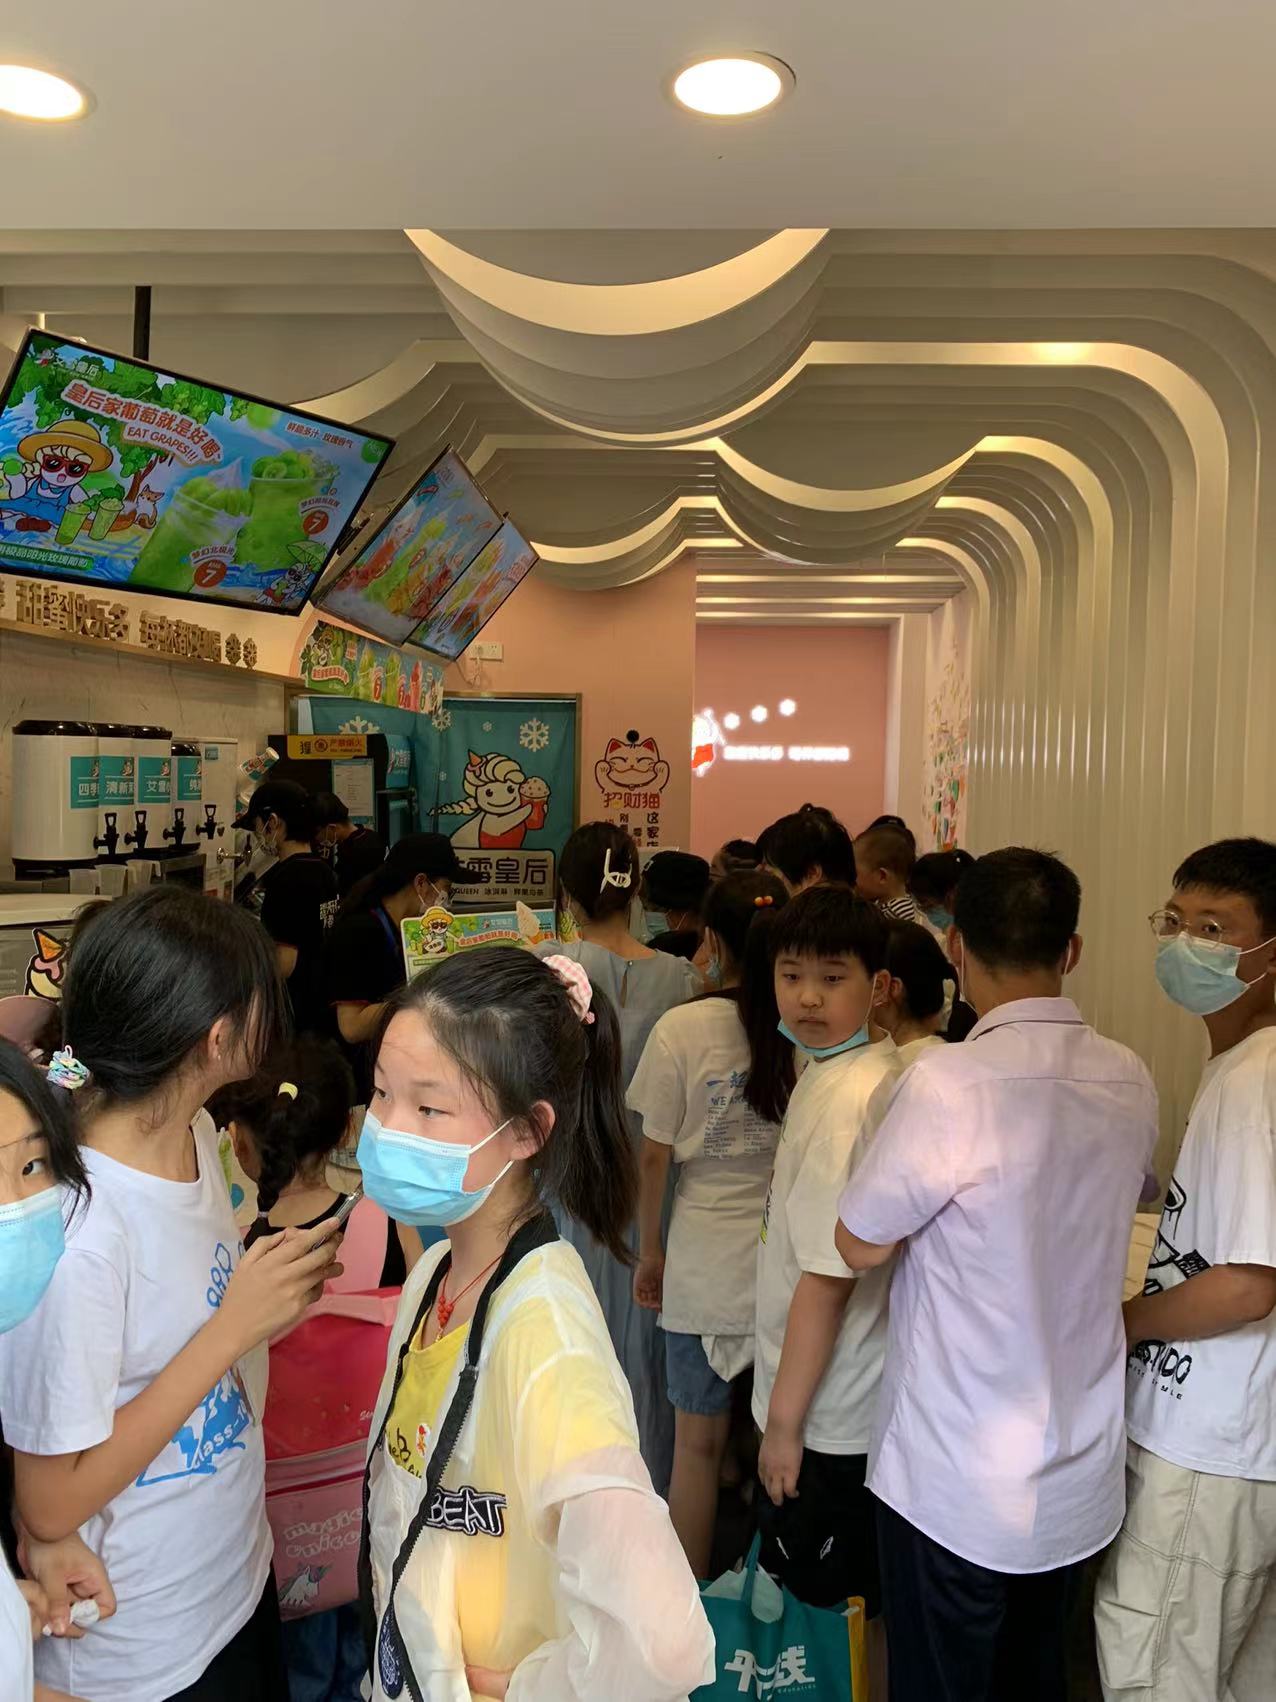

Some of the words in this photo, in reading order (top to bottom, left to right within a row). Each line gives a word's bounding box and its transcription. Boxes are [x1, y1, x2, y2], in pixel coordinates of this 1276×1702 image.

[127, 426, 150, 438] EAT
[150, 431, 199, 461] GRAPES!!!
[202, 569, 217, 584] 7
[603, 792, 660, 809] 招财猫
[459, 856, 549, 885] 雪皇后
[711, 1096, 728, 1106] WE
